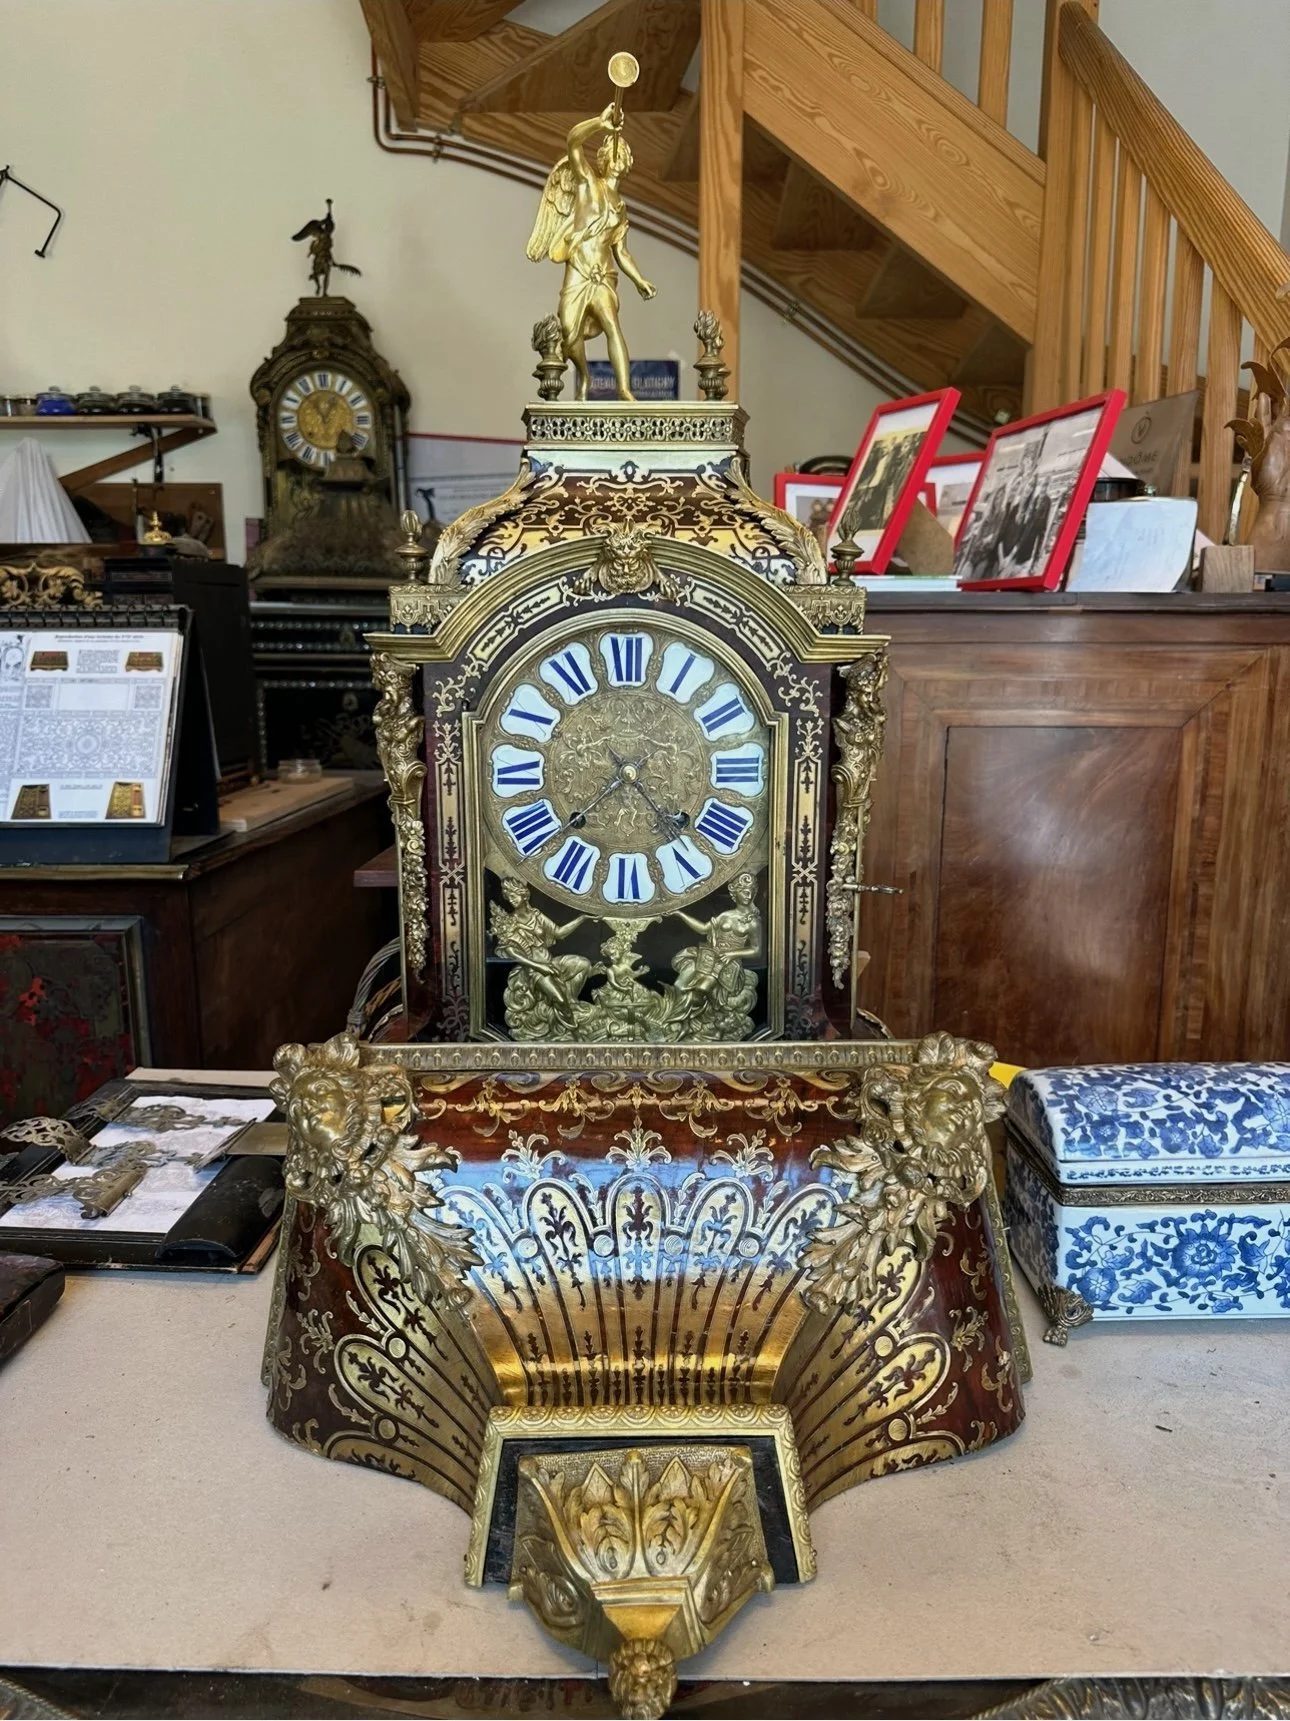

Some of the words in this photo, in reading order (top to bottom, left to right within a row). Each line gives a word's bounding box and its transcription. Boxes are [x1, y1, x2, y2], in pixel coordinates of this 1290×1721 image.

[547, 650, 592, 701] XI
[609, 636, 644, 683] XII
[669, 652, 699, 695] I
[699, 695, 747, 736] II
[496, 755, 541, 787] IX
[715, 754, 760, 785] III
[505, 800, 561, 855] VIII
[695, 800, 750, 851] IIII
[552, 839, 595, 892] VII
[615, 857, 643, 900] VI
[671, 846, 705, 889] V
